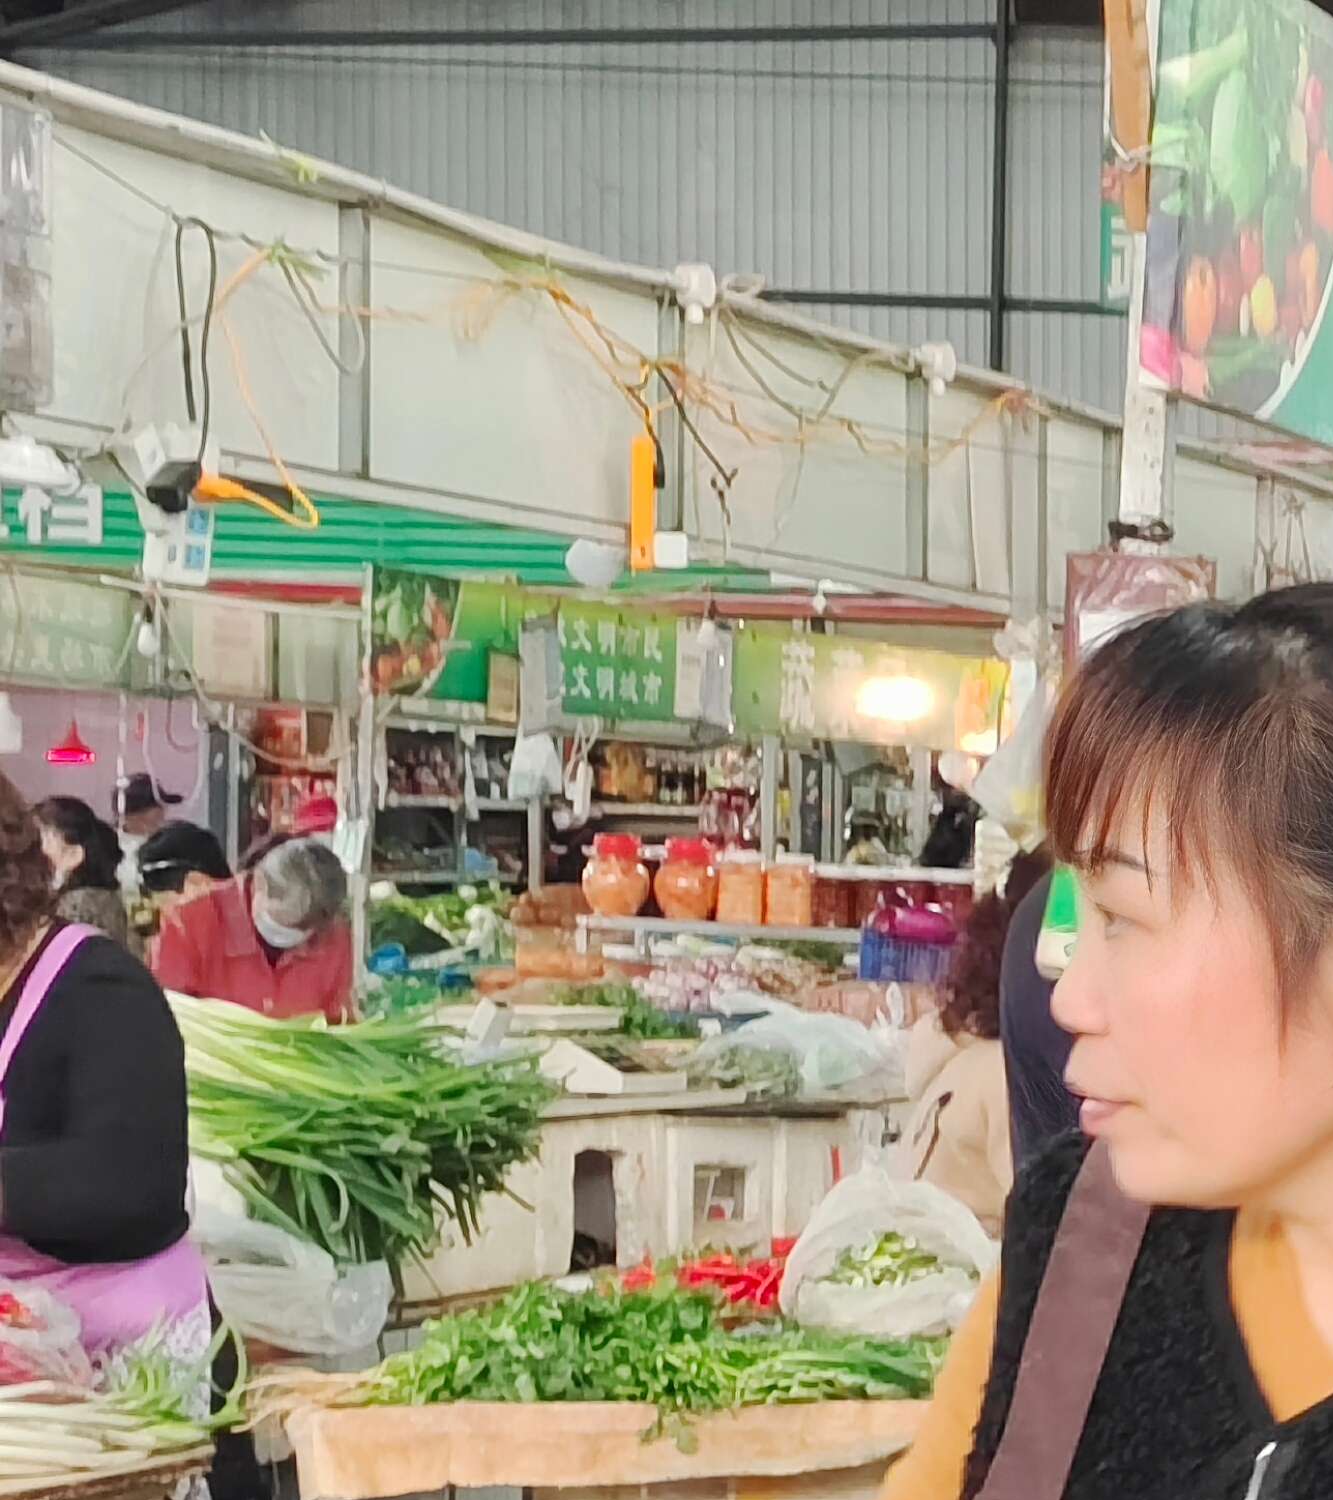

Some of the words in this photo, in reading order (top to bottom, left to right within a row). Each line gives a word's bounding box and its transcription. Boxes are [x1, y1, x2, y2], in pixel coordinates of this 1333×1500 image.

[558, 611, 663, 664] 文明市民
[560, 657, 663, 705] 文明城市
